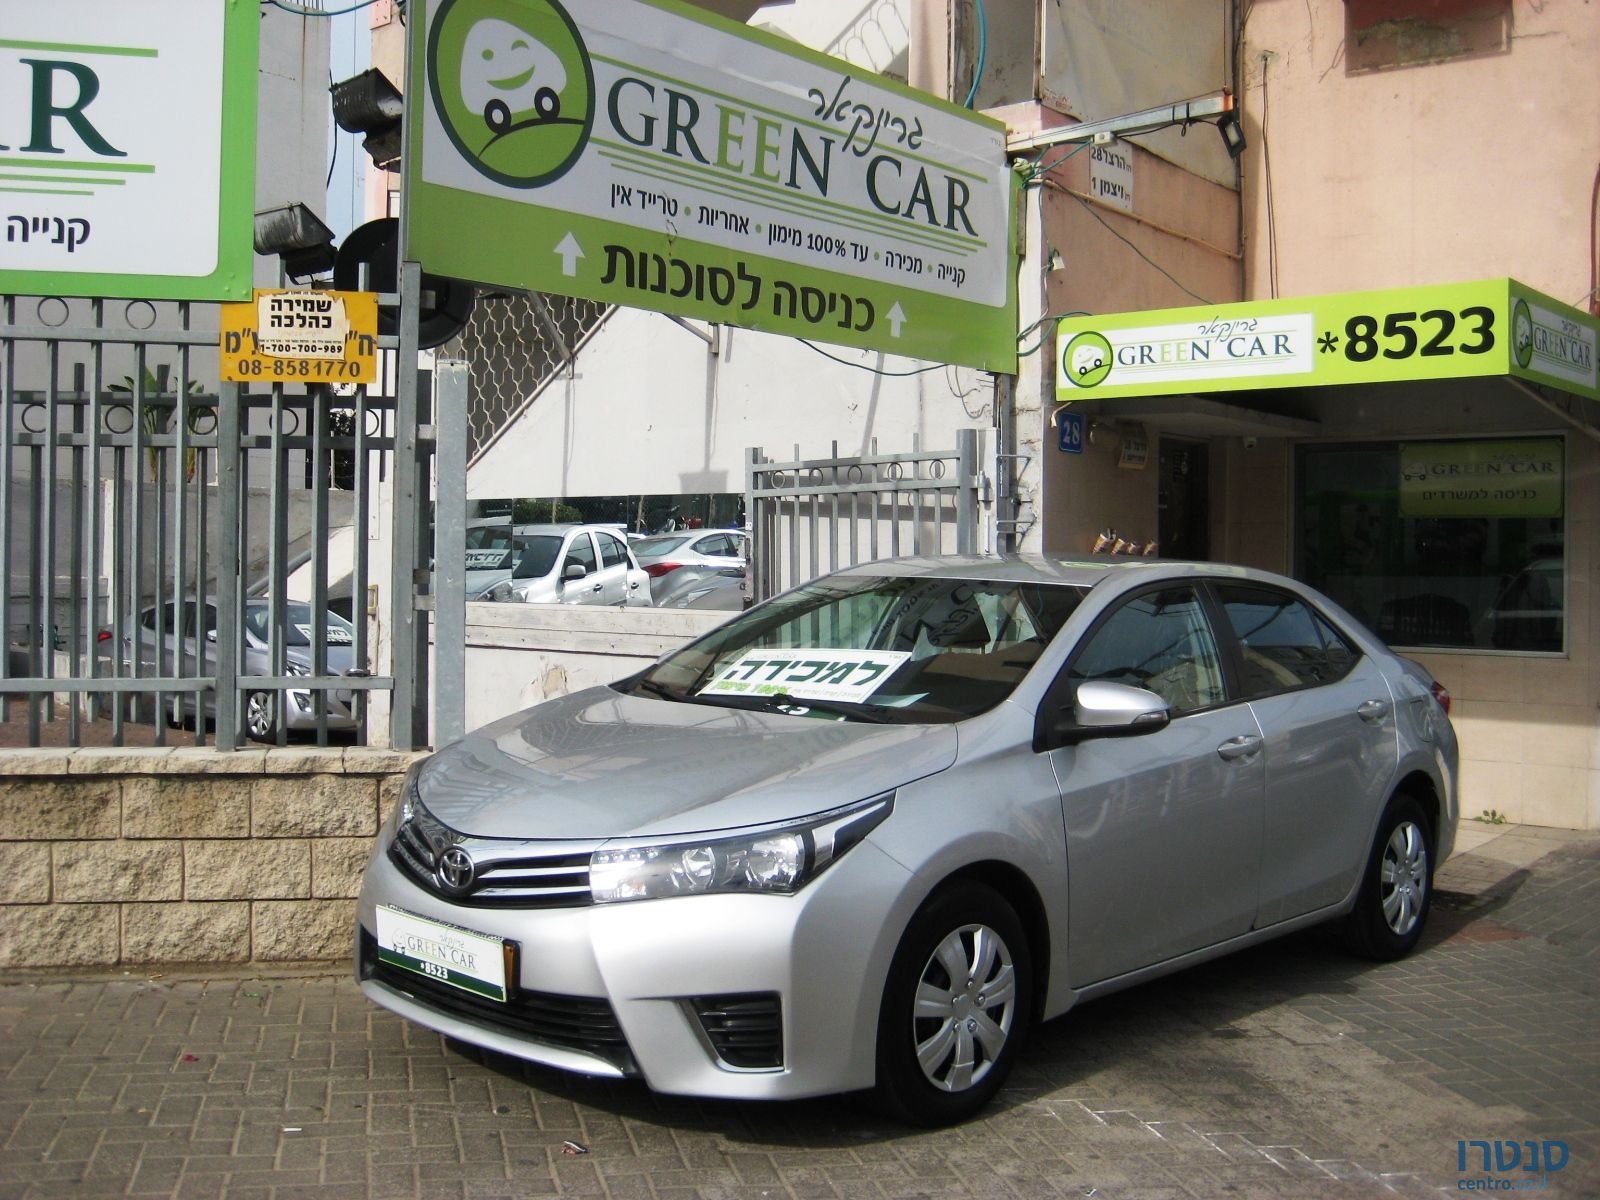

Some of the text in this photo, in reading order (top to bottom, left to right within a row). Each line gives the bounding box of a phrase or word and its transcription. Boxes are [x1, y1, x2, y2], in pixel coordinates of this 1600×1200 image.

[0, 57, 128, 157] R
[808, 75, 923, 157] גרינקאר
[607, 77, 979, 237] GREEN CAR
[1091, 176, 1096, 190] 1
[1100, 178, 1124, 200] ויצמן
[7, 215, 91, 252] קנייה
[610, 183, 966, 288] קנייה מכירה עד 100% מימון אחריות טרייד אין
[600, 244, 875, 332] כניסה לסוכנות
[270, 298, 332, 313] שמירה
[270, 313, 332, 329] כהלכה
[260, 344, 342, 354] 1-700-700-989
[1117, 334, 1294, 367] GREEN CAR
[1534, 327, 1567, 360] GREEN
[1571, 341, 1591, 368] CAR
[238, 359, 361, 377] 08-8581770
[1062, 420, 1081, 445] 28
[1431, 462, 1554, 476] GREEN CAR
[1494, 488, 1537, 500] כניסה
[724, 660, 889, 687] למכירה
[408, 936, 446, 962] GREEN
[451, 951, 476, 969] CAR
